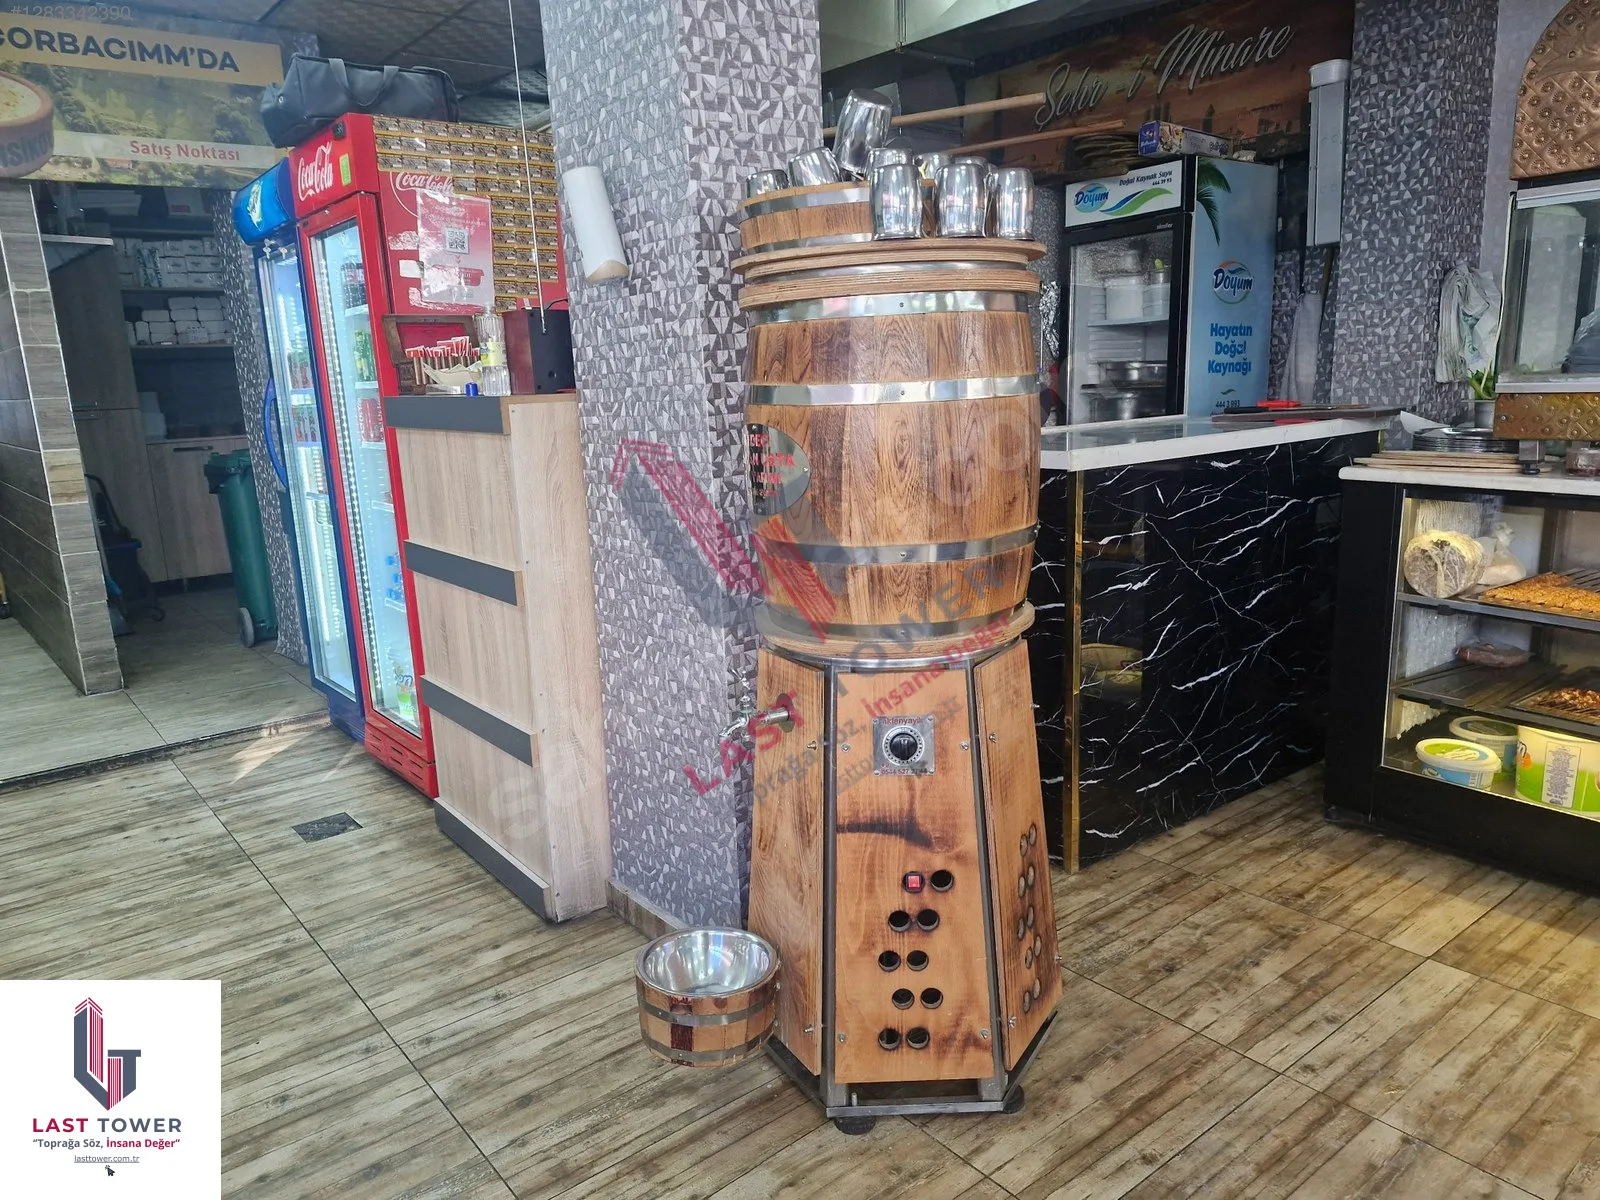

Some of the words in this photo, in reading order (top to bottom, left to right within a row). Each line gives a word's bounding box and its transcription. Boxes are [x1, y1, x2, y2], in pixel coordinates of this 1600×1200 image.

[0, 26, 240, 73] ORBACIMM’DA
[1154, 24, 1296, 95] Minare
[130, 140, 172, 158] Satış
[177, 142, 240, 161] Noktası
[1075, 190, 1109, 207] Doyum
[1213, 268, 1253, 296] Doyum
[1210, 323, 1253, 340] Hayatın
[1215, 340, 1247, 358] Doğal
[1208, 357, 1252, 377] Kaynağı
